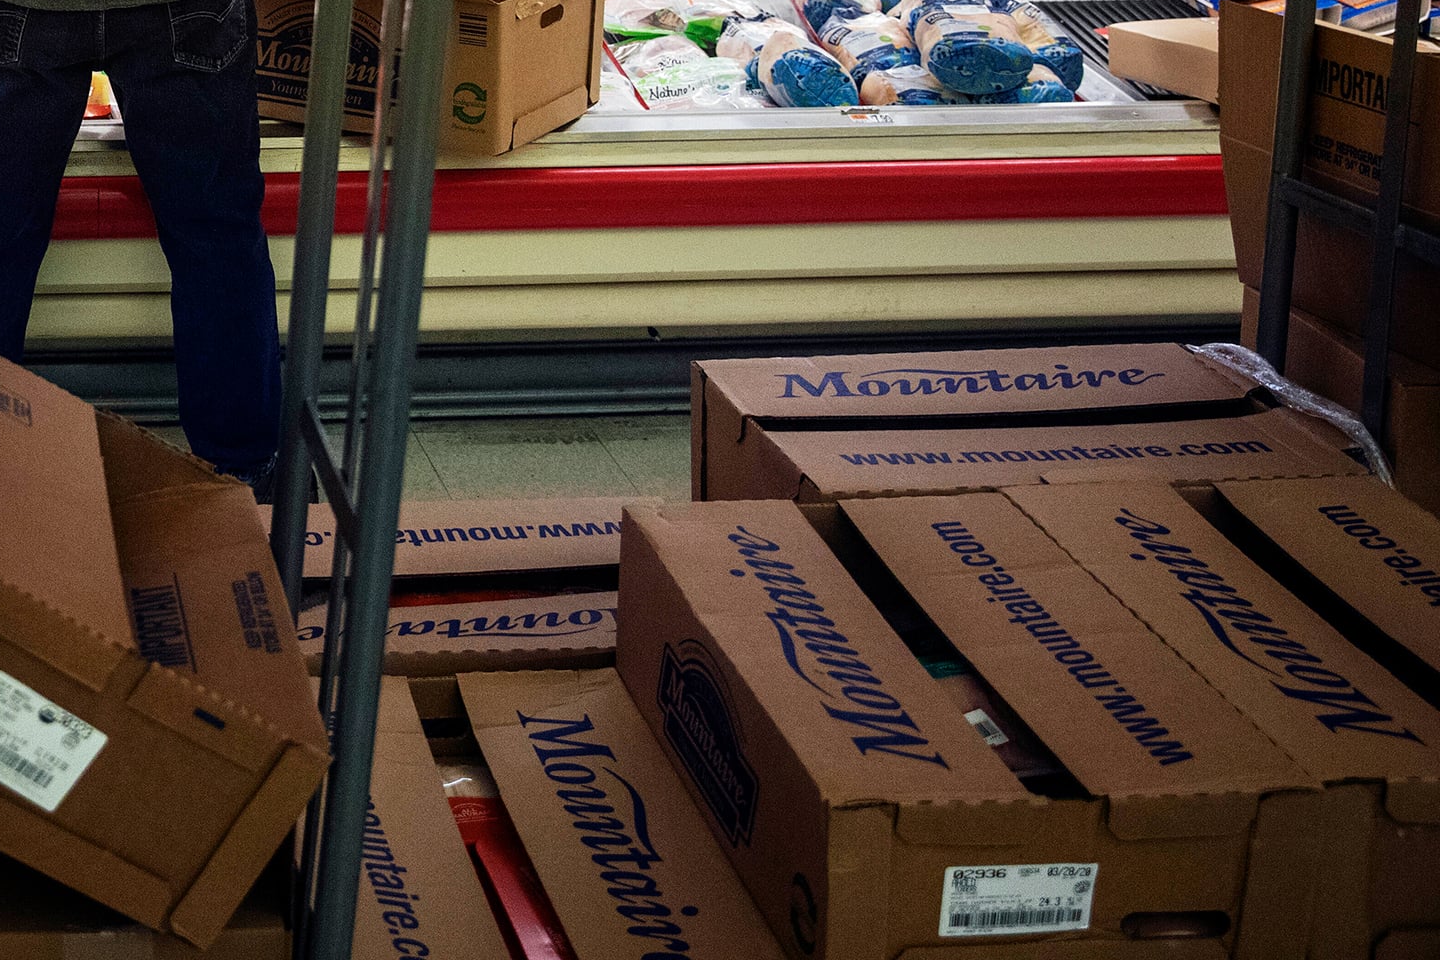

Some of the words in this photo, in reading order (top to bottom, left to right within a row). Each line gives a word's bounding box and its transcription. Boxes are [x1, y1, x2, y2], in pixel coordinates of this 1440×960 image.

[773, 363, 1166, 400] Mountaire
[839, 436, 1274, 467] www.mountaire.com
[1317, 502, 1440, 607] aire.com
[726, 524, 951, 772] Mountaire
[930, 520, 1195, 767] www.mountaire.com
[1114, 506, 1428, 747] Mountaire
[953, 868, 1008, 880] 02936
